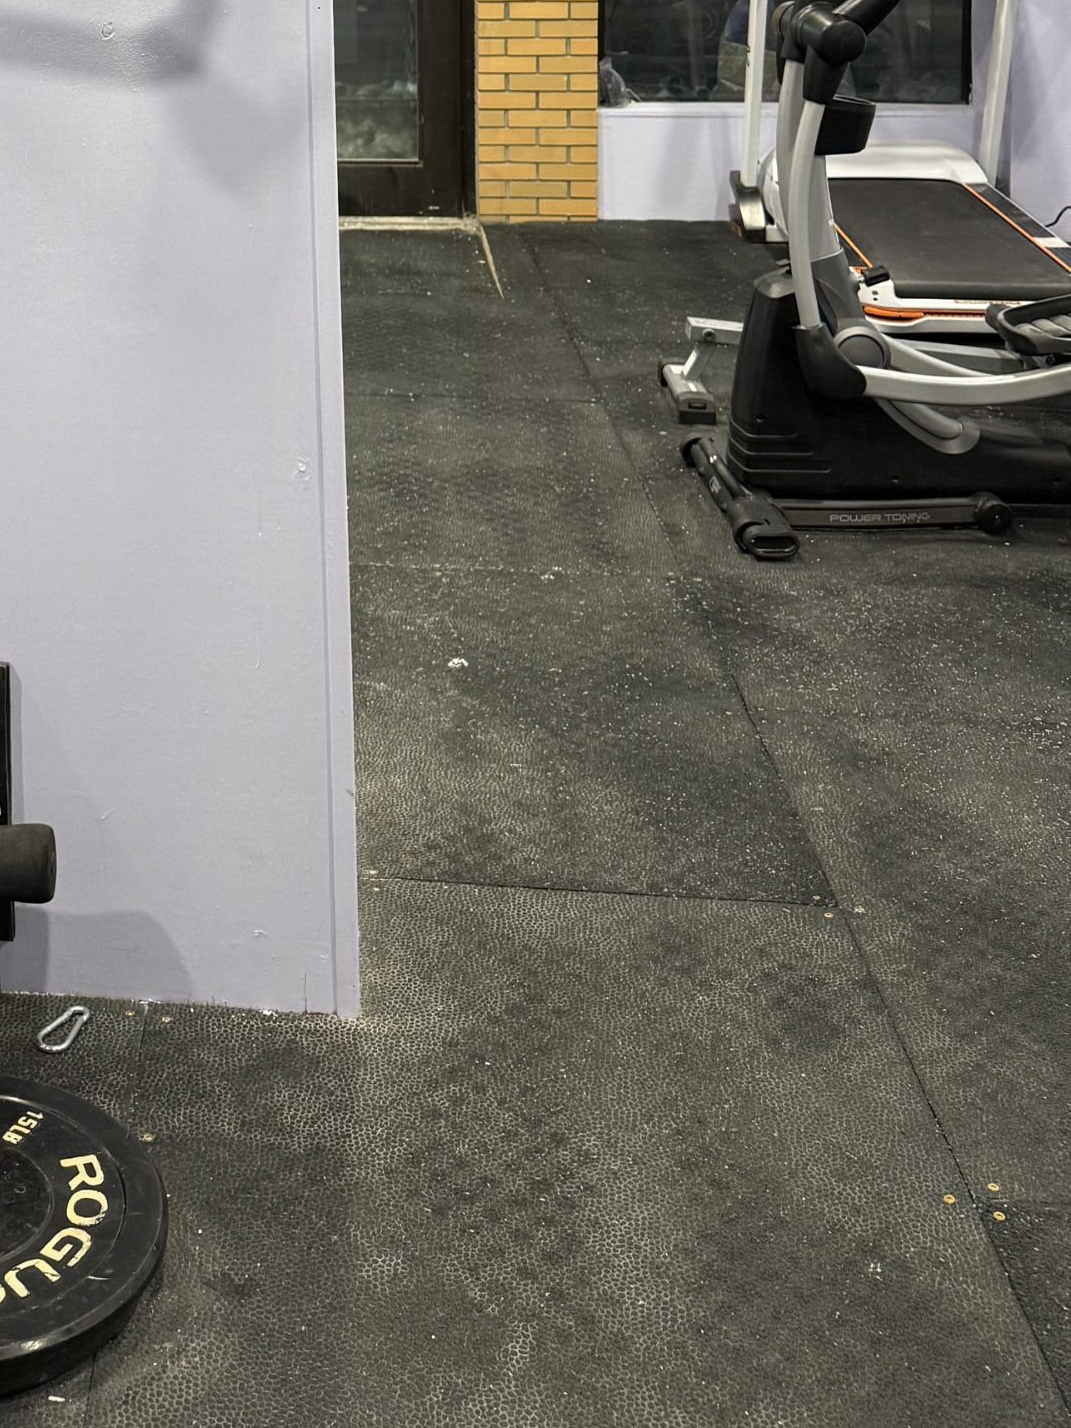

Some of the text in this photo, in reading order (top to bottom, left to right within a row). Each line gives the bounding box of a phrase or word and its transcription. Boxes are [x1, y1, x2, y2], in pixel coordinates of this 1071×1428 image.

[829, 513, 930, 523] POWER TONING
[2, 1110, 44, 1145] 15LB
